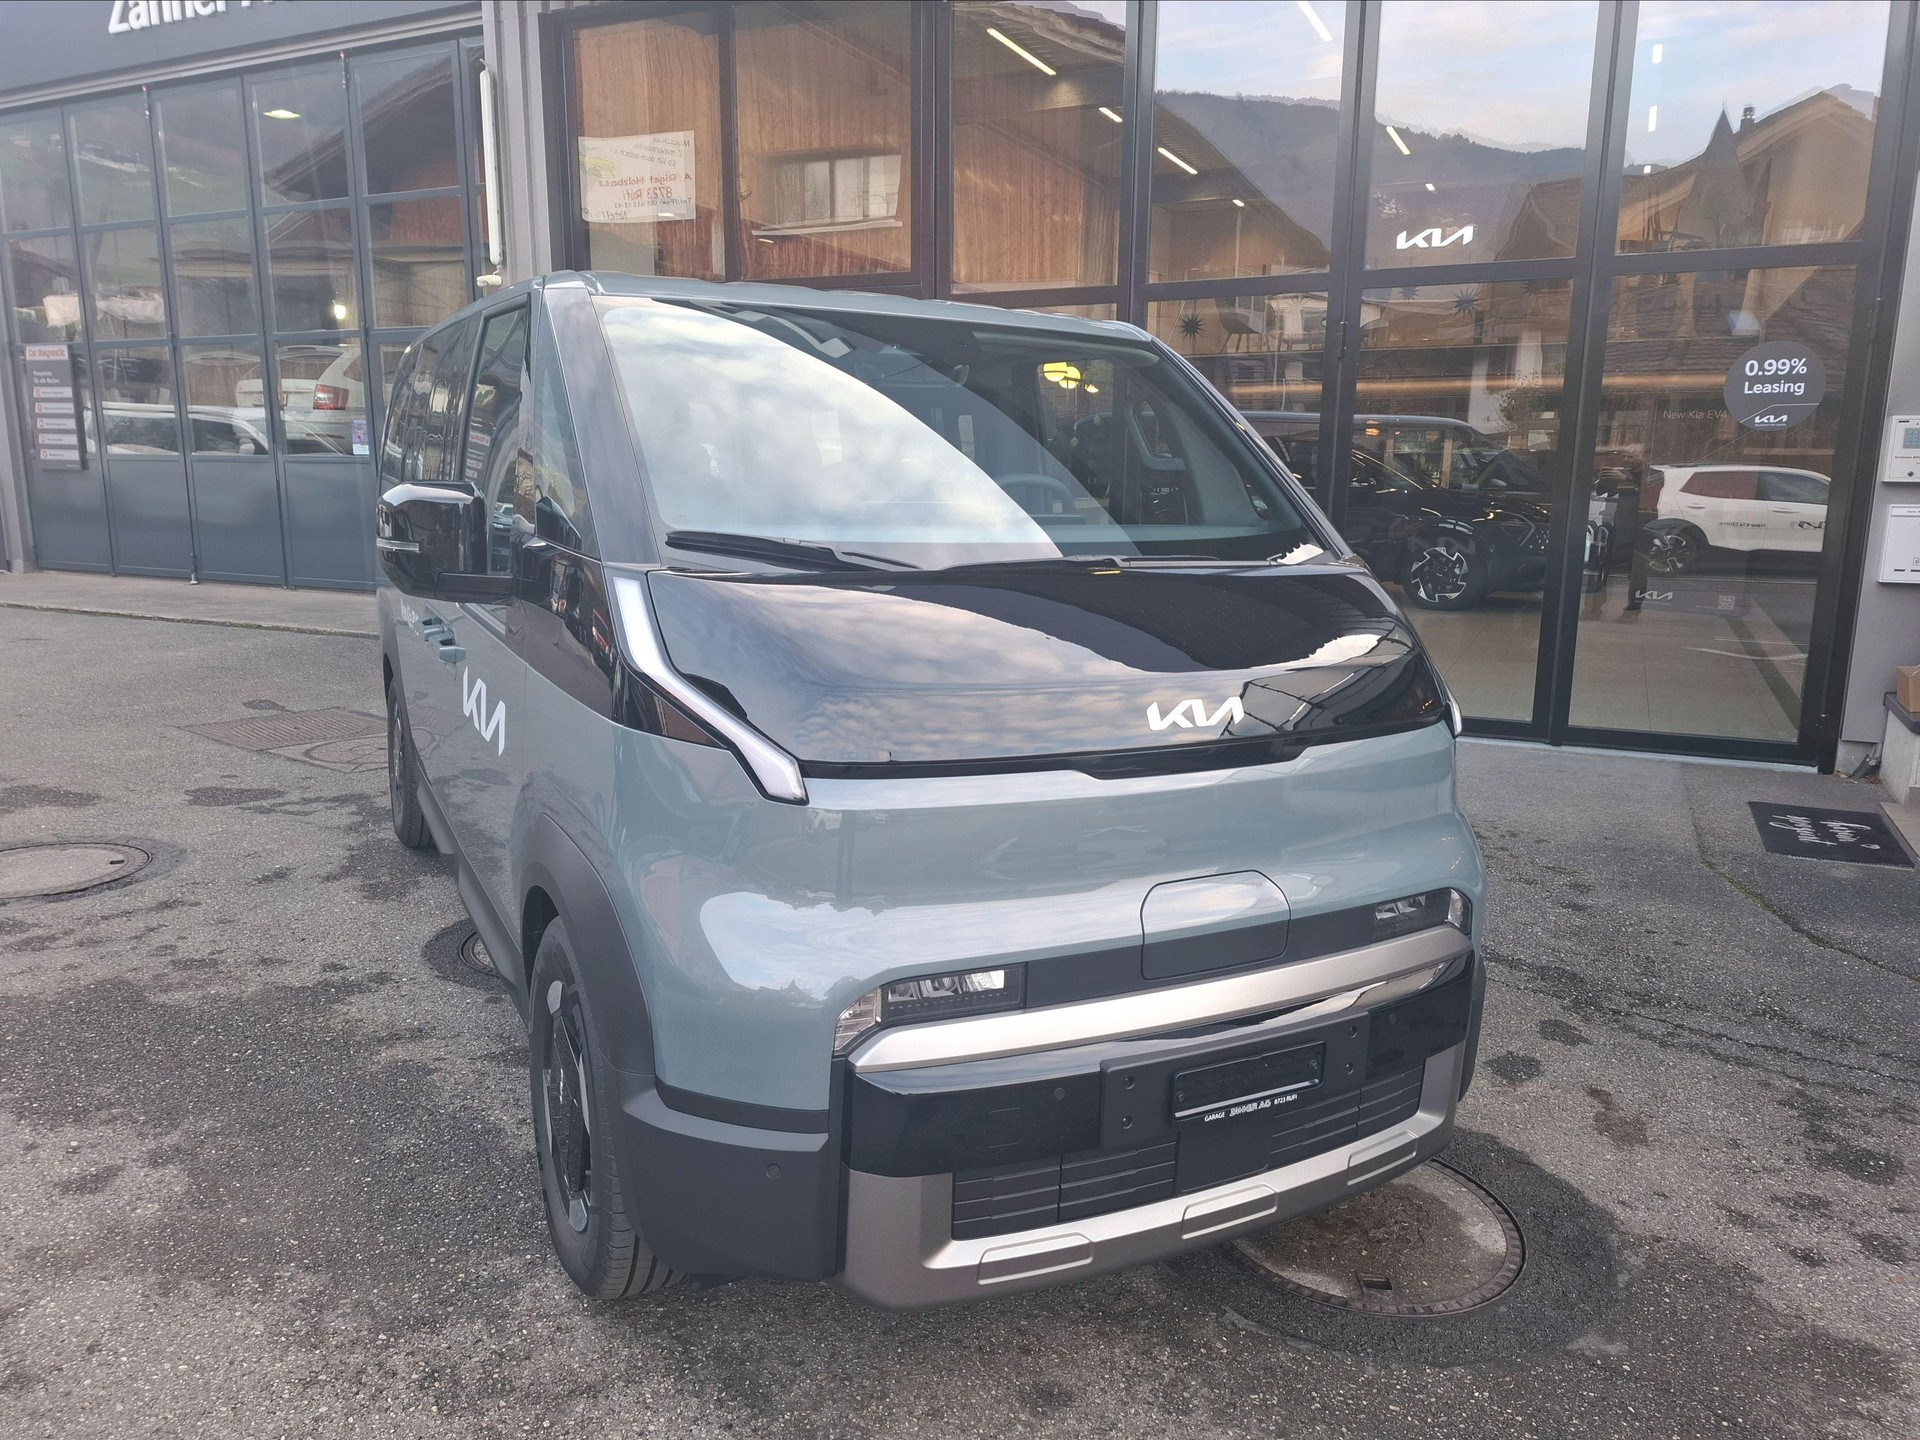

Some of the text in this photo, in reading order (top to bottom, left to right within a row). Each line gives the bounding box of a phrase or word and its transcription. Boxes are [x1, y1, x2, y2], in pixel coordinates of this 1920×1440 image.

[1396, 225, 1474, 250] KIA
[1745, 358, 1807, 376] 0.99%
[1744, 380, 1805, 396] Leasing
[1663, 409, 1728, 419] New Kia EV4
[1754, 415, 1788, 423] KIA
[463, 665, 506, 757] KIA
[1146, 696, 1245, 731] KIA
[1204, 1112, 1225, 1122] GARAGE
[1274, 1097, 1286, 1105] 8723
